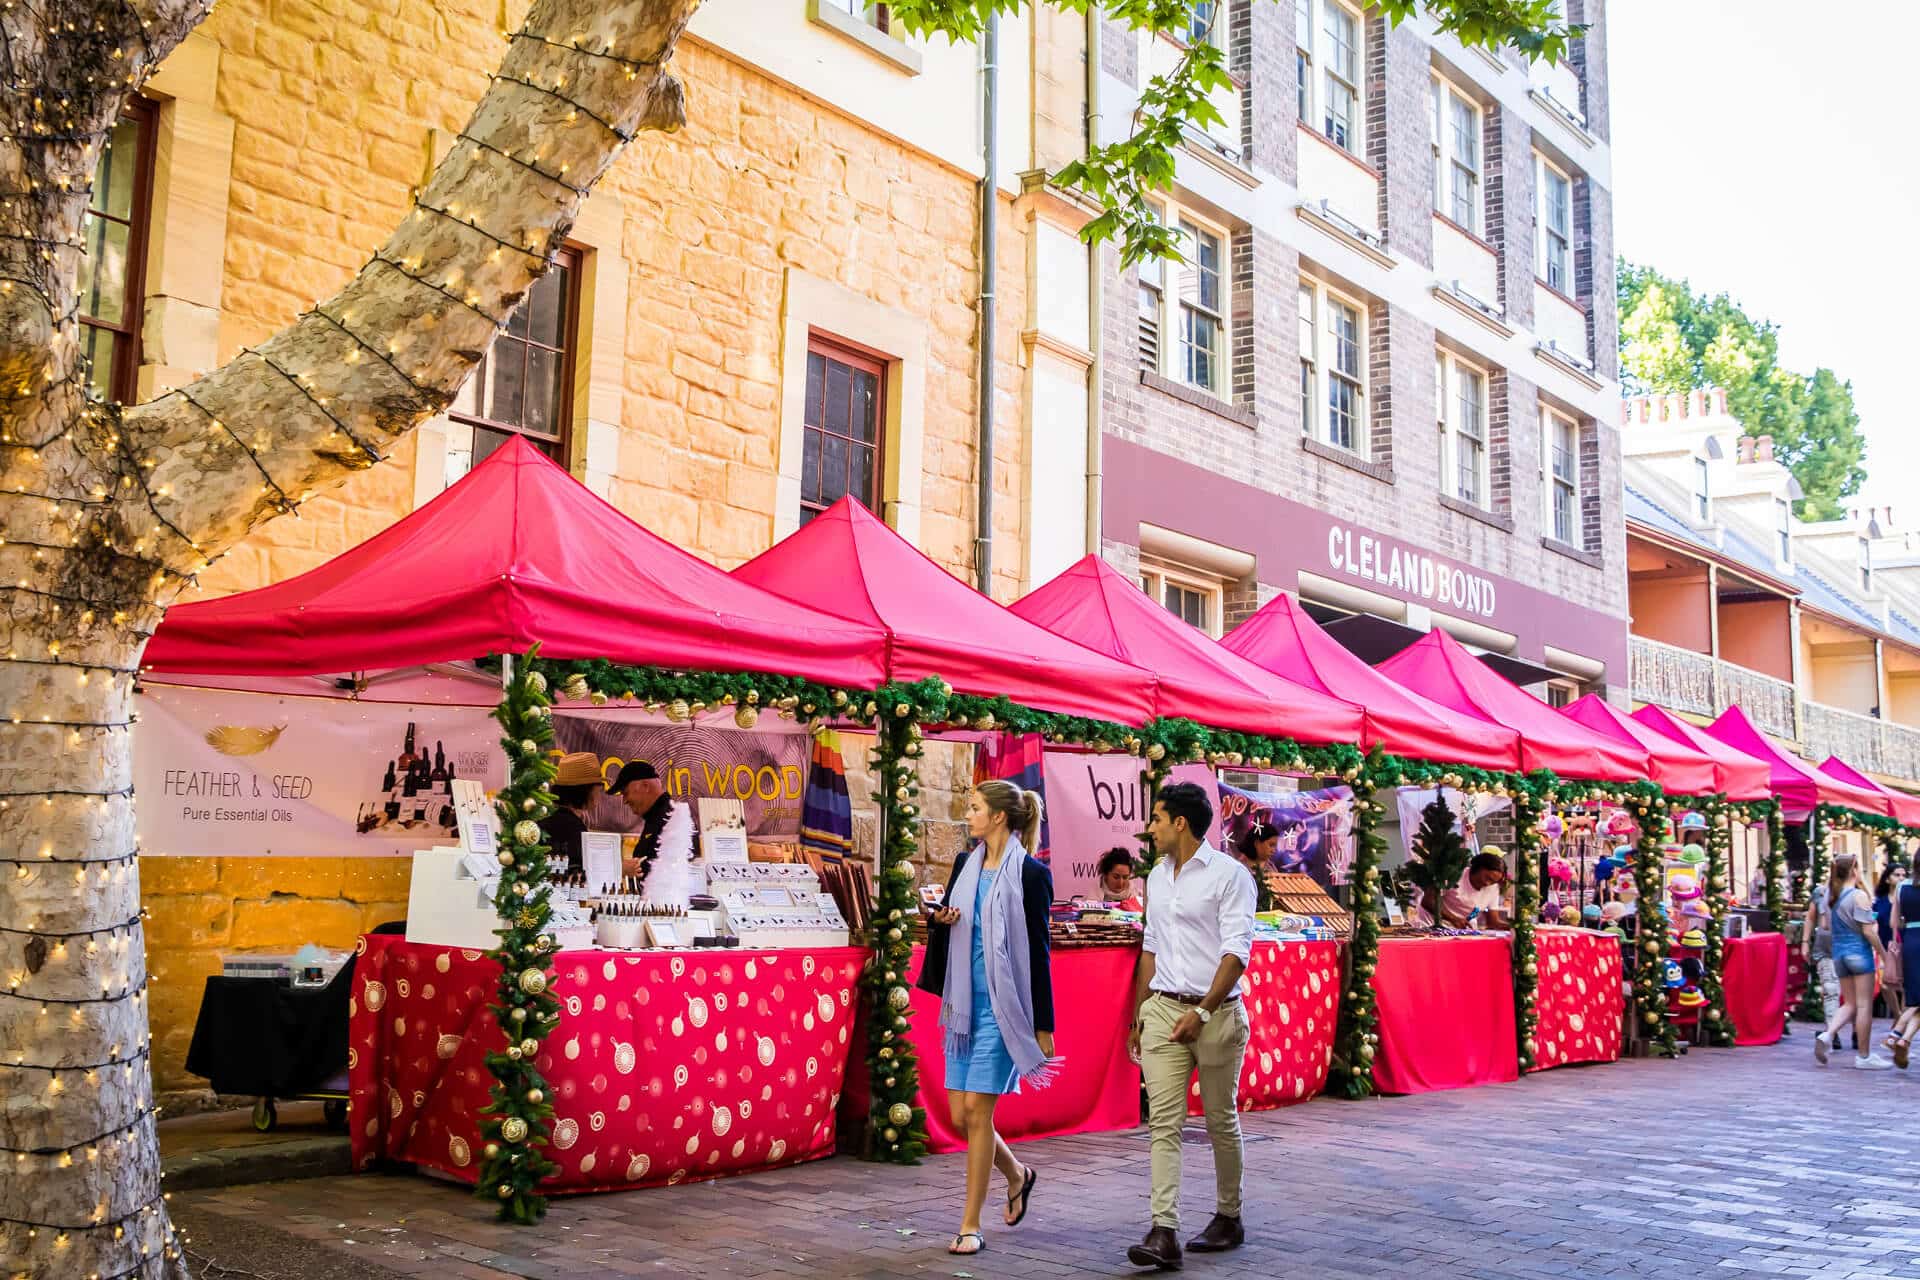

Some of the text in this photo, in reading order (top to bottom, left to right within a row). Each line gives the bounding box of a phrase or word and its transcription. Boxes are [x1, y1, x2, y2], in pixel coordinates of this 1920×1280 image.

[164, 770, 313, 800] FEATHER & SEED
[666, 759, 692, 797] in
[701, 760, 803, 801] WOOD
[182, 807, 293, 822] Pure Essential Oils
